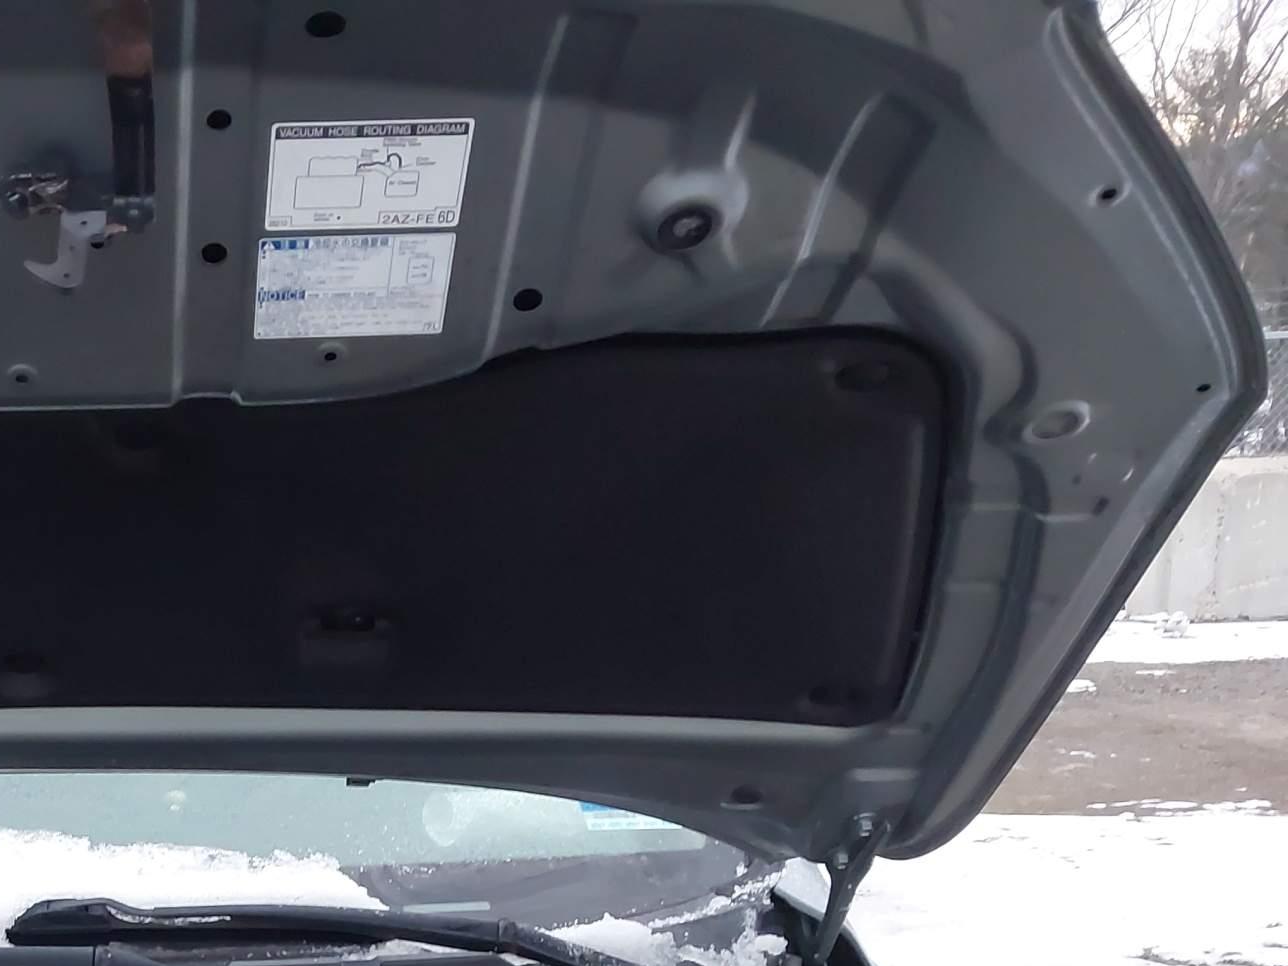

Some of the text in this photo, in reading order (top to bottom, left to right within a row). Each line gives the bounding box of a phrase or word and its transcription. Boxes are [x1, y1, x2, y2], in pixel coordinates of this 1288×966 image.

[279, 123, 466, 138] VACUUM HOSE ROUTING DIAGRAM
[382, 209, 456, 225] 2AZ-FE 6D
